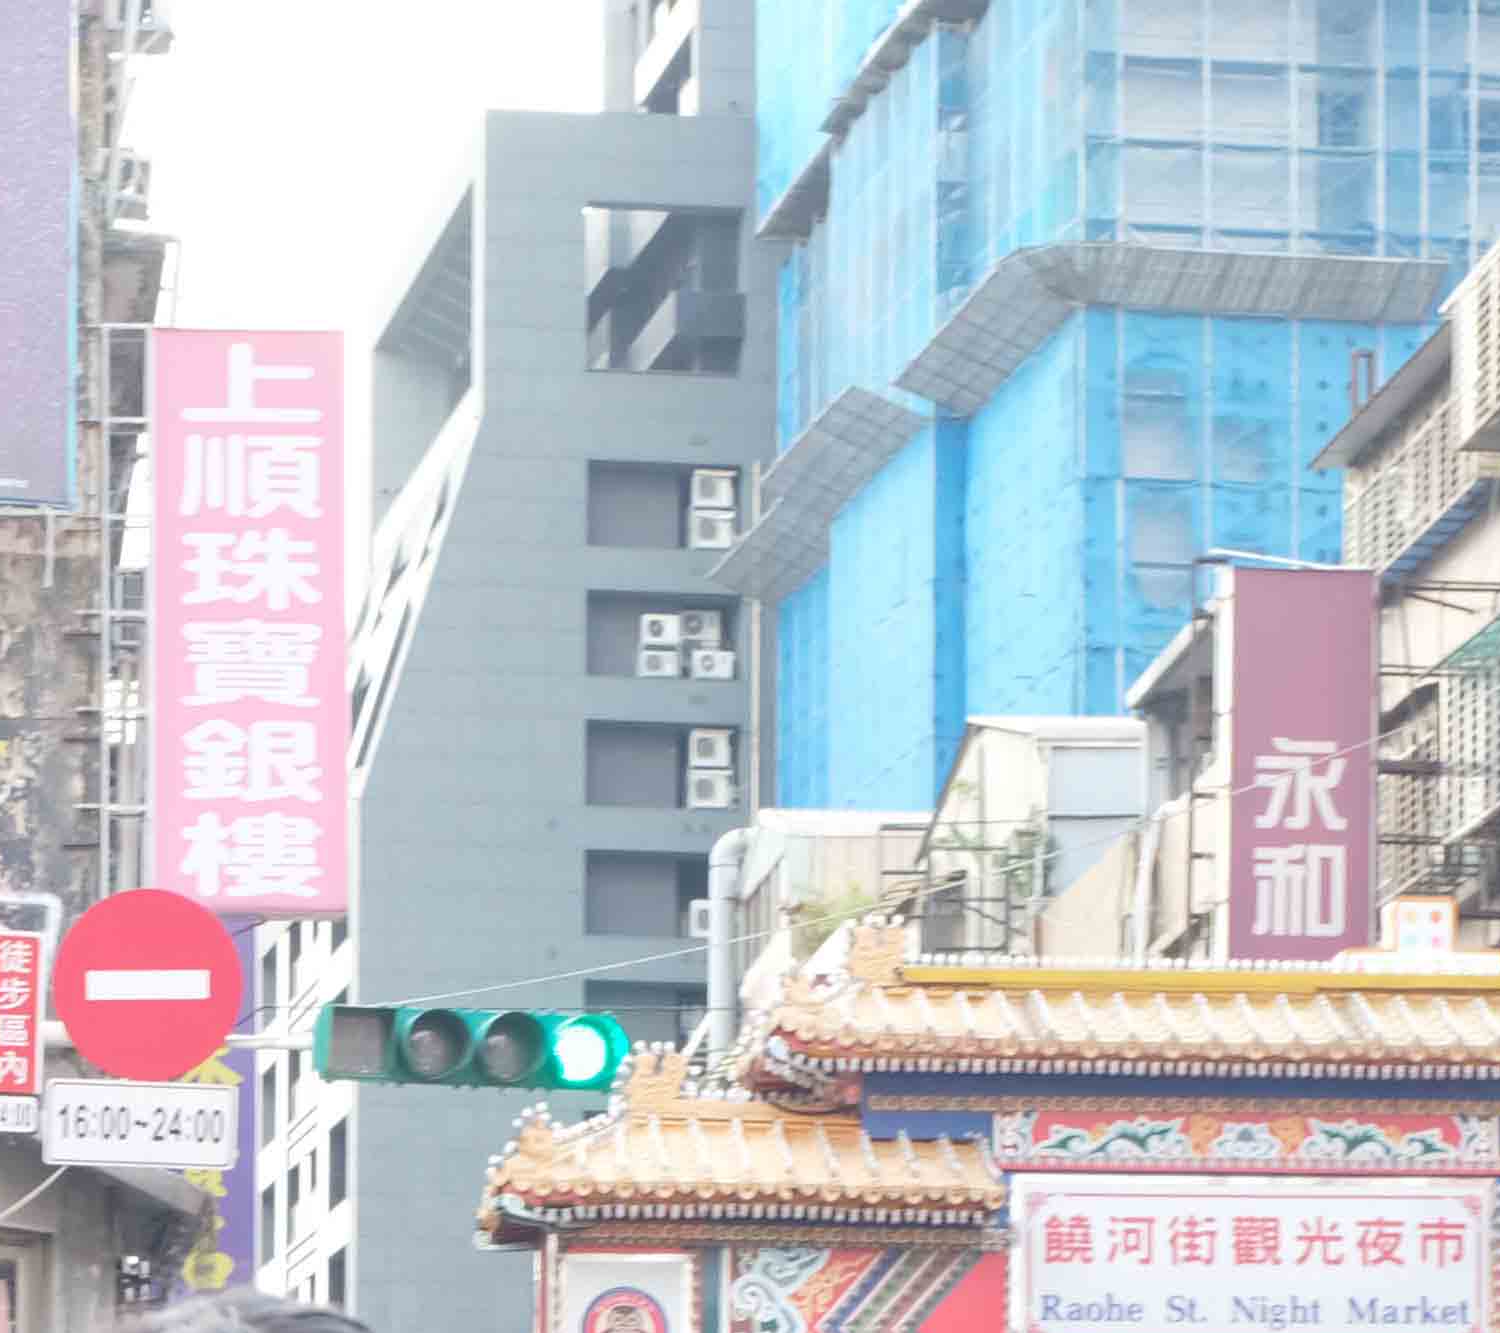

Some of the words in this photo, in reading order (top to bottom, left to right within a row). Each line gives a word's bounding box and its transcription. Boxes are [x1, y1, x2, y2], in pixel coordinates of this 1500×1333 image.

[181, 342, 322, 898] 上順珠寶銀樓
[1253, 736, 1349, 937] 永和
[56, 1104, 225, 1144] 16:00~24:00
[1042, 1215, 1468, 1269] 饒河街觀光夜市
[1041, 1294, 1144, 1324] Raohe
[1166, 1296, 1208, 1324] St.
[1231, 1294, 1321, 1329] Night
[1345, 1296, 1471, 1326] Market
